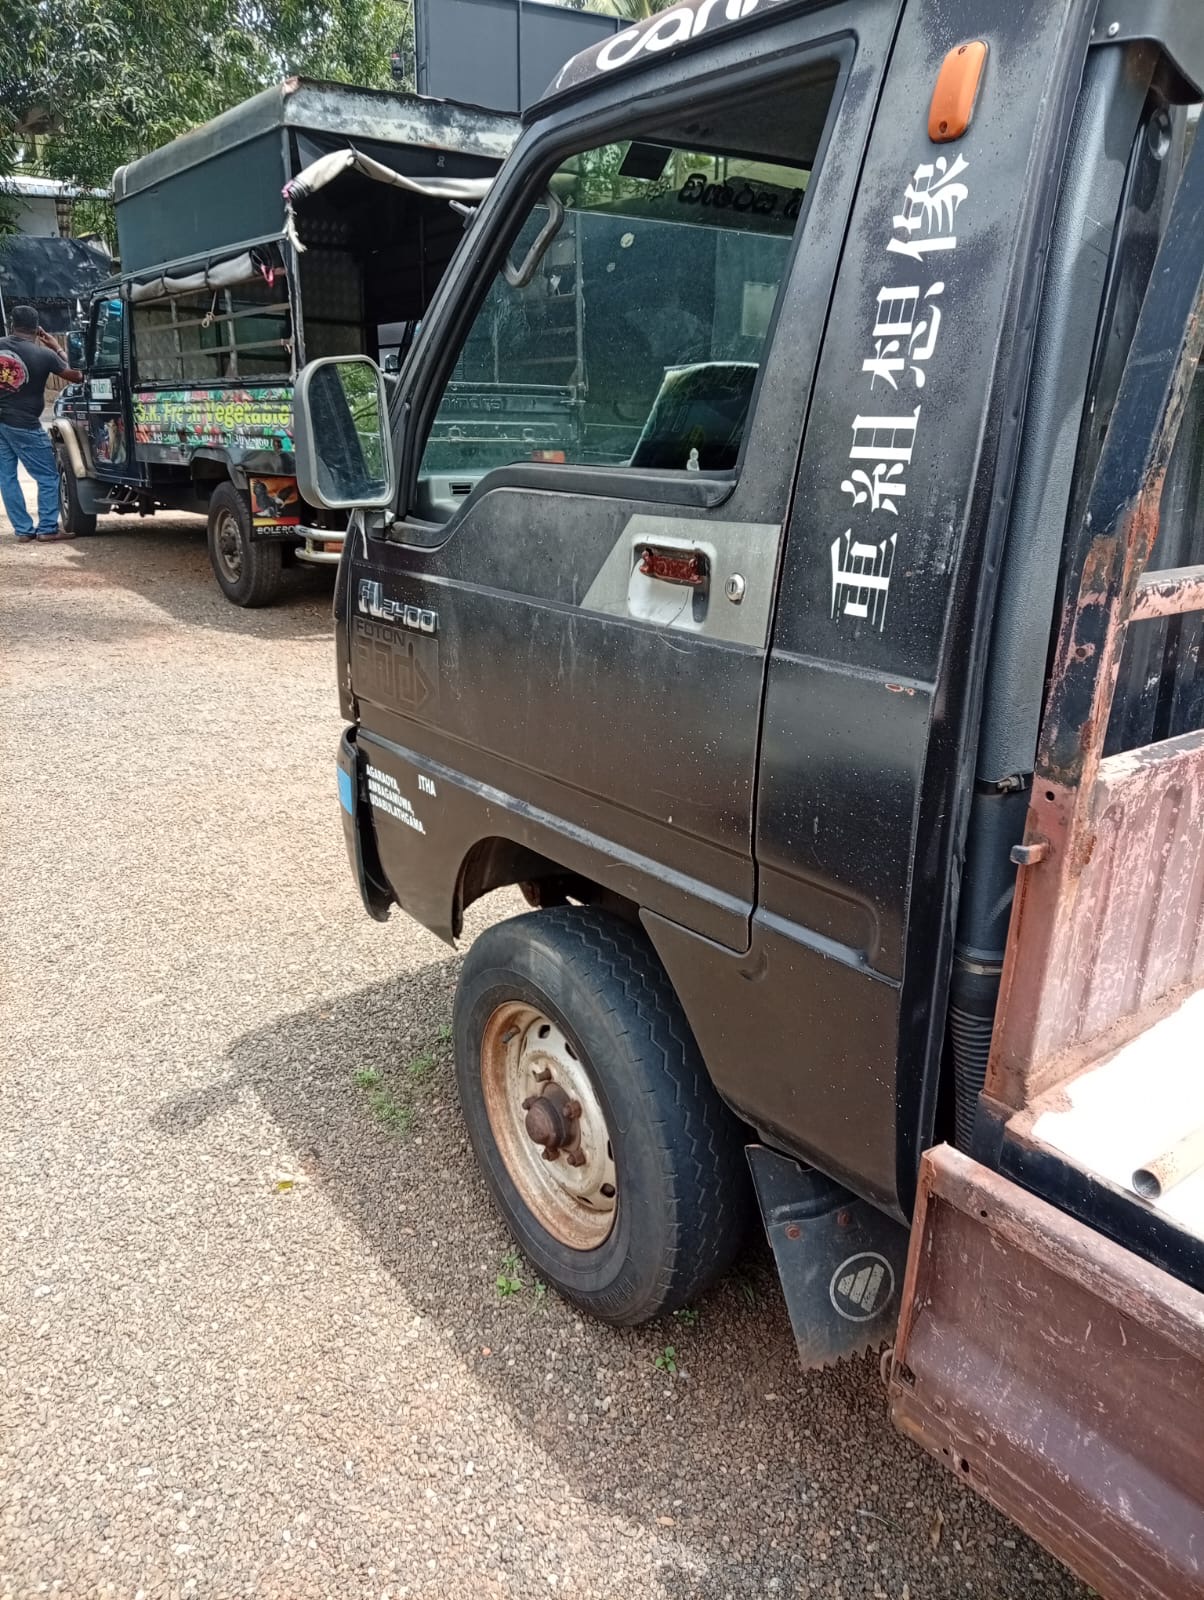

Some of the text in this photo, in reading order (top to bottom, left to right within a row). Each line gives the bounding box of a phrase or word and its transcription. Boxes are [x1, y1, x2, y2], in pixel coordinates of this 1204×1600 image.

[831, 152, 970, 633] 重組想像
[205, 399, 290, 427] Vegetable
[356, 620, 405, 647] FOTON
[418, 774, 437, 797] ITHA
